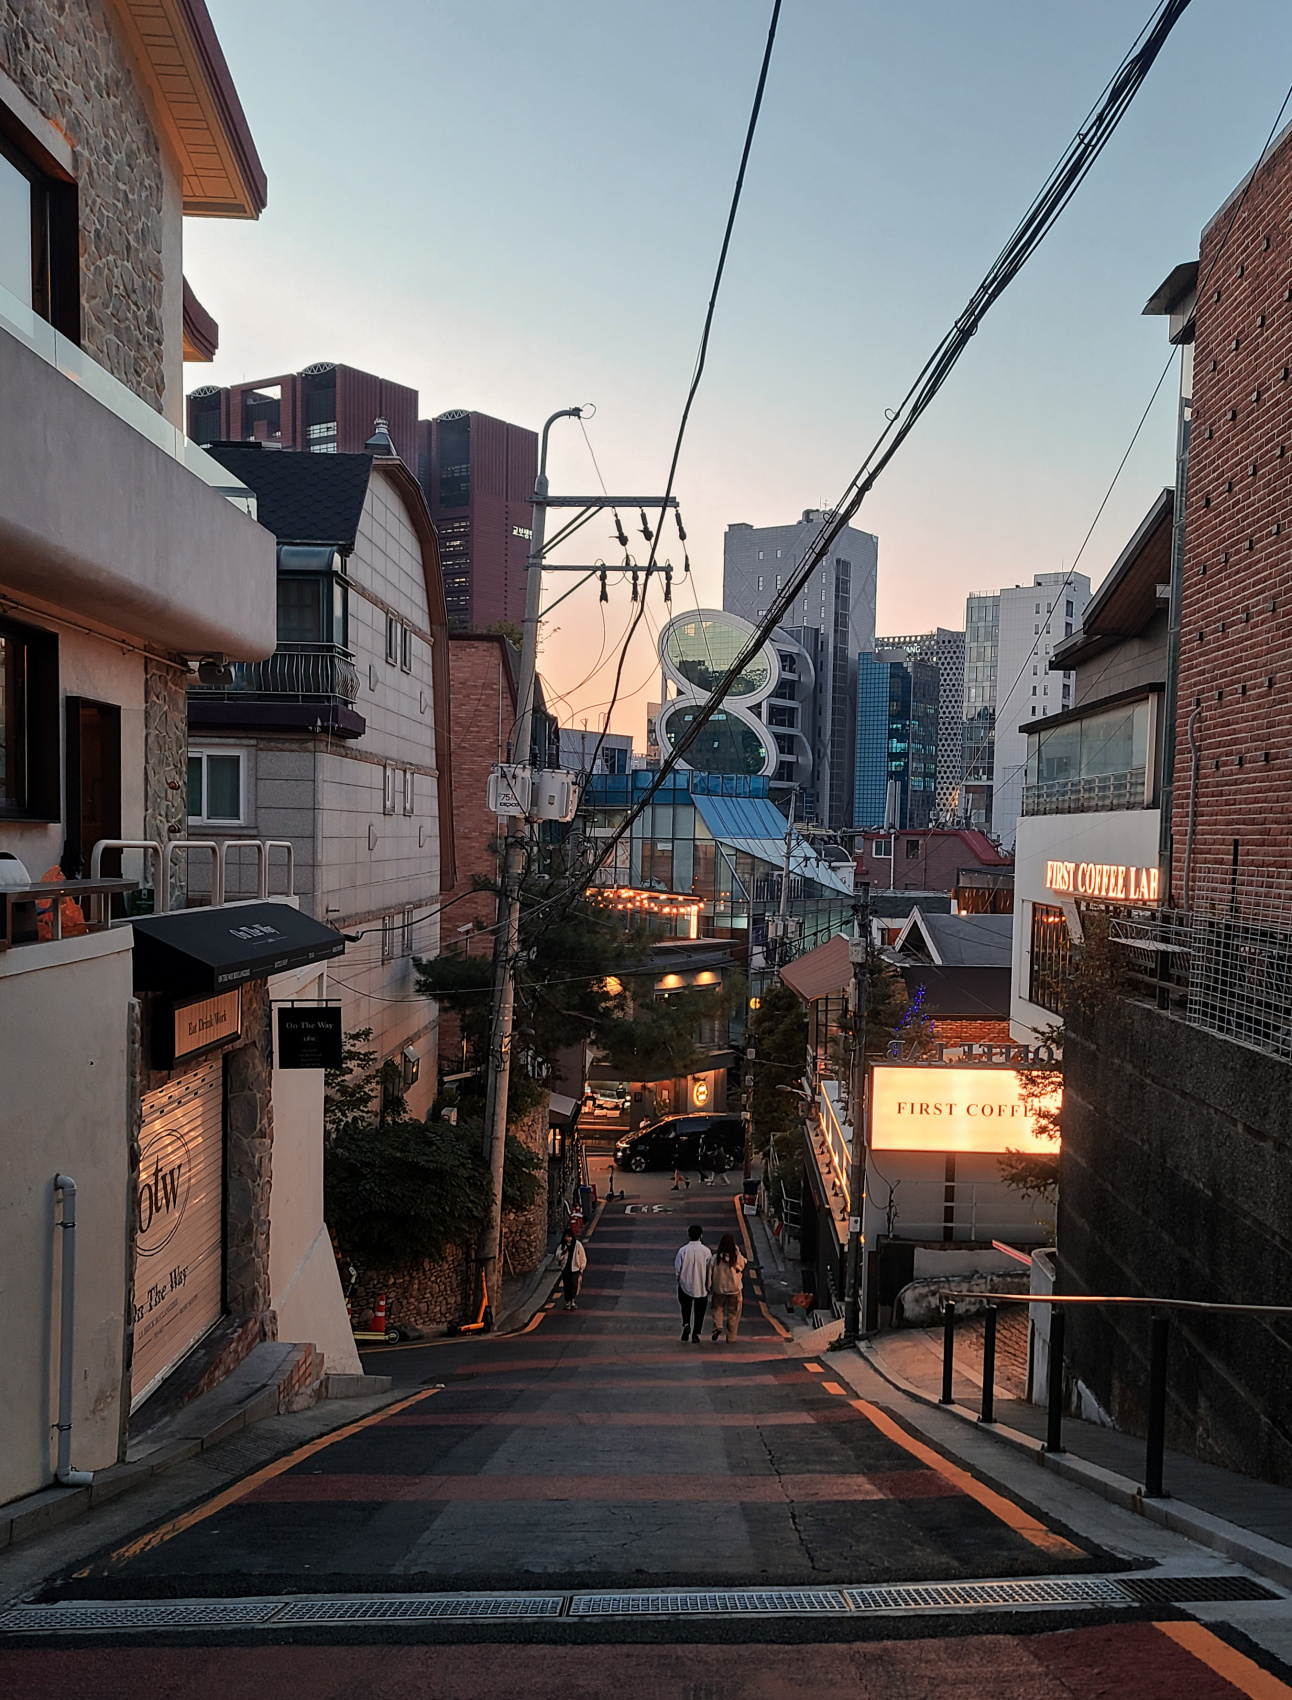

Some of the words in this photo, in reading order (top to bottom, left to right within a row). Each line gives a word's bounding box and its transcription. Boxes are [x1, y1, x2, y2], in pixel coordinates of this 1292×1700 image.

[1046, 860, 1076, 891] FIRST
[1078, 862, 1126, 898] COFFEE
[188, 1022, 197, 1036] Eat
[198, 1014, 214, 1032] Drink
[300, 1021, 316, 1029] The
[317, 1021, 334, 1030] Way
[897, 1101, 957, 1116] FIRST
[139, 1154, 183, 1234] otw
[147, 1282, 167, 1313] The
[169, 1264, 189, 1293] Way
